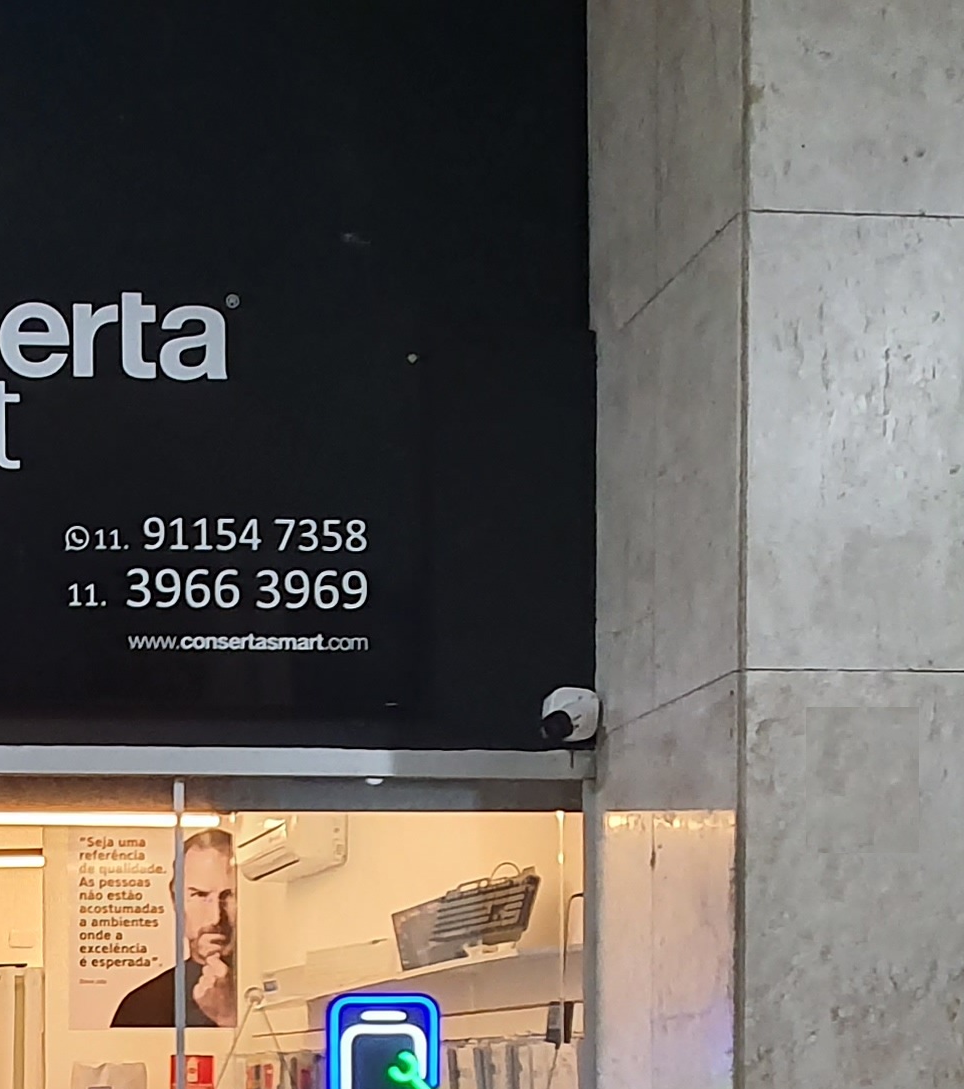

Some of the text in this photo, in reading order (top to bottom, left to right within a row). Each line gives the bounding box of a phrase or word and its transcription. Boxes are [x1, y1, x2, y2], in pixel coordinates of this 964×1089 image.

[94, 516, 368, 552] 11. 91154 7358
[68, 567, 368, 610] 11. 3966 3969
[127, 633, 369, 651] www.consertasmart.com
[118, 838, 146, 848] uma
[79, 877, 151, 890] As pessoas
[79, 890, 143, 901] não estão
[79, 903, 165, 914] acostumadas
[79, 916, 159, 928] a ambientes
[79, 930, 123, 941] onde a
[79, 943, 148, 954] excelência
[79, 956, 87, 968] é
